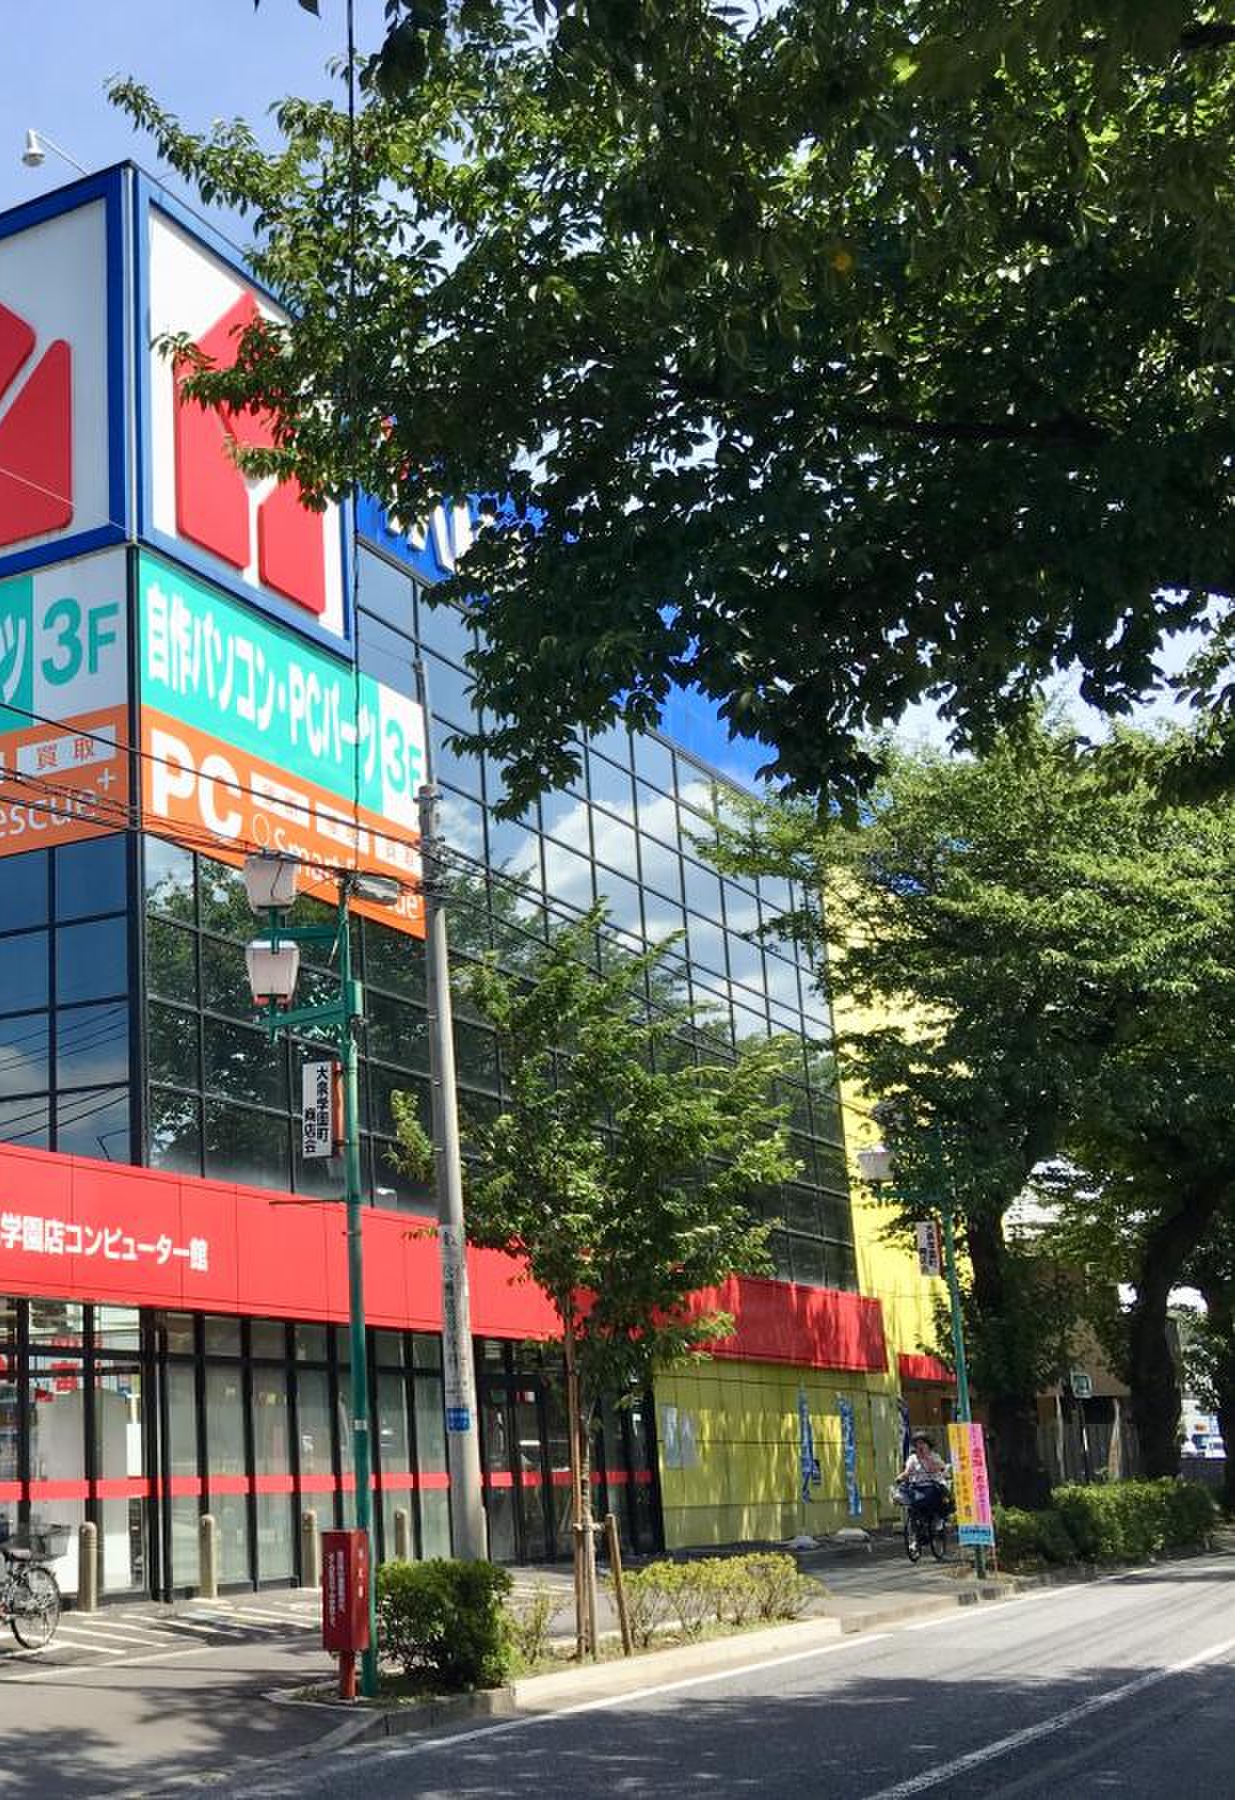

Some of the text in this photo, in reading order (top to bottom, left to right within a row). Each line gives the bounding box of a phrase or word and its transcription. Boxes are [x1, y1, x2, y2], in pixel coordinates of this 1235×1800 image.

[42, 598, 121, 686] 3F
[147, 581, 423, 798] 自作パソコン・PCパーツ 3F
[151, 728, 243, 843] PC
